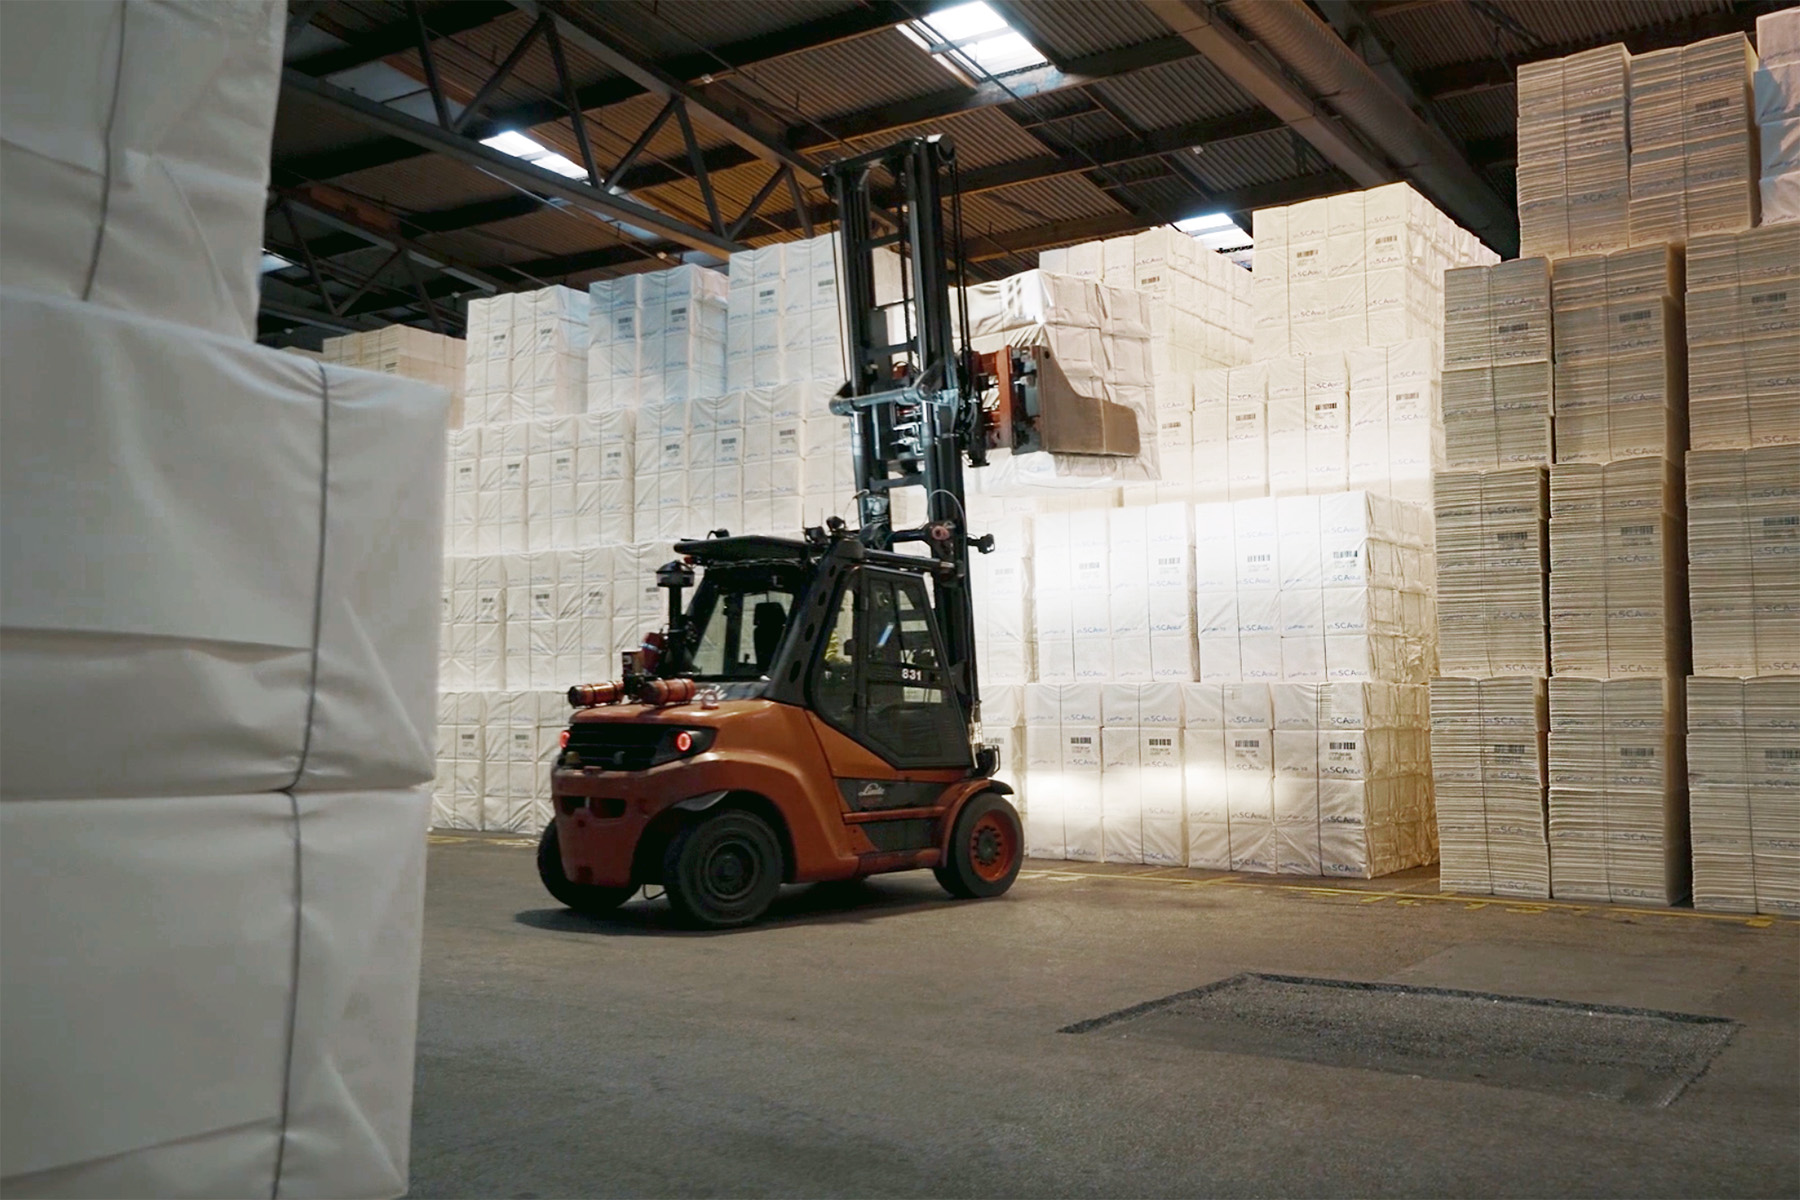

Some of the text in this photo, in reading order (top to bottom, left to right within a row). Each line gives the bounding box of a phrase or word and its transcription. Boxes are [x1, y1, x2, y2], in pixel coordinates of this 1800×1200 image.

[1703, 222, 1726, 231] SCA
[1762, 322, 1787, 331] SCA
[1768, 378, 1793, 386] SCA
[1764, 435, 1789, 443] SCA
[1764, 546, 1789, 554] SCA
[902, 668, 921, 681] 831
